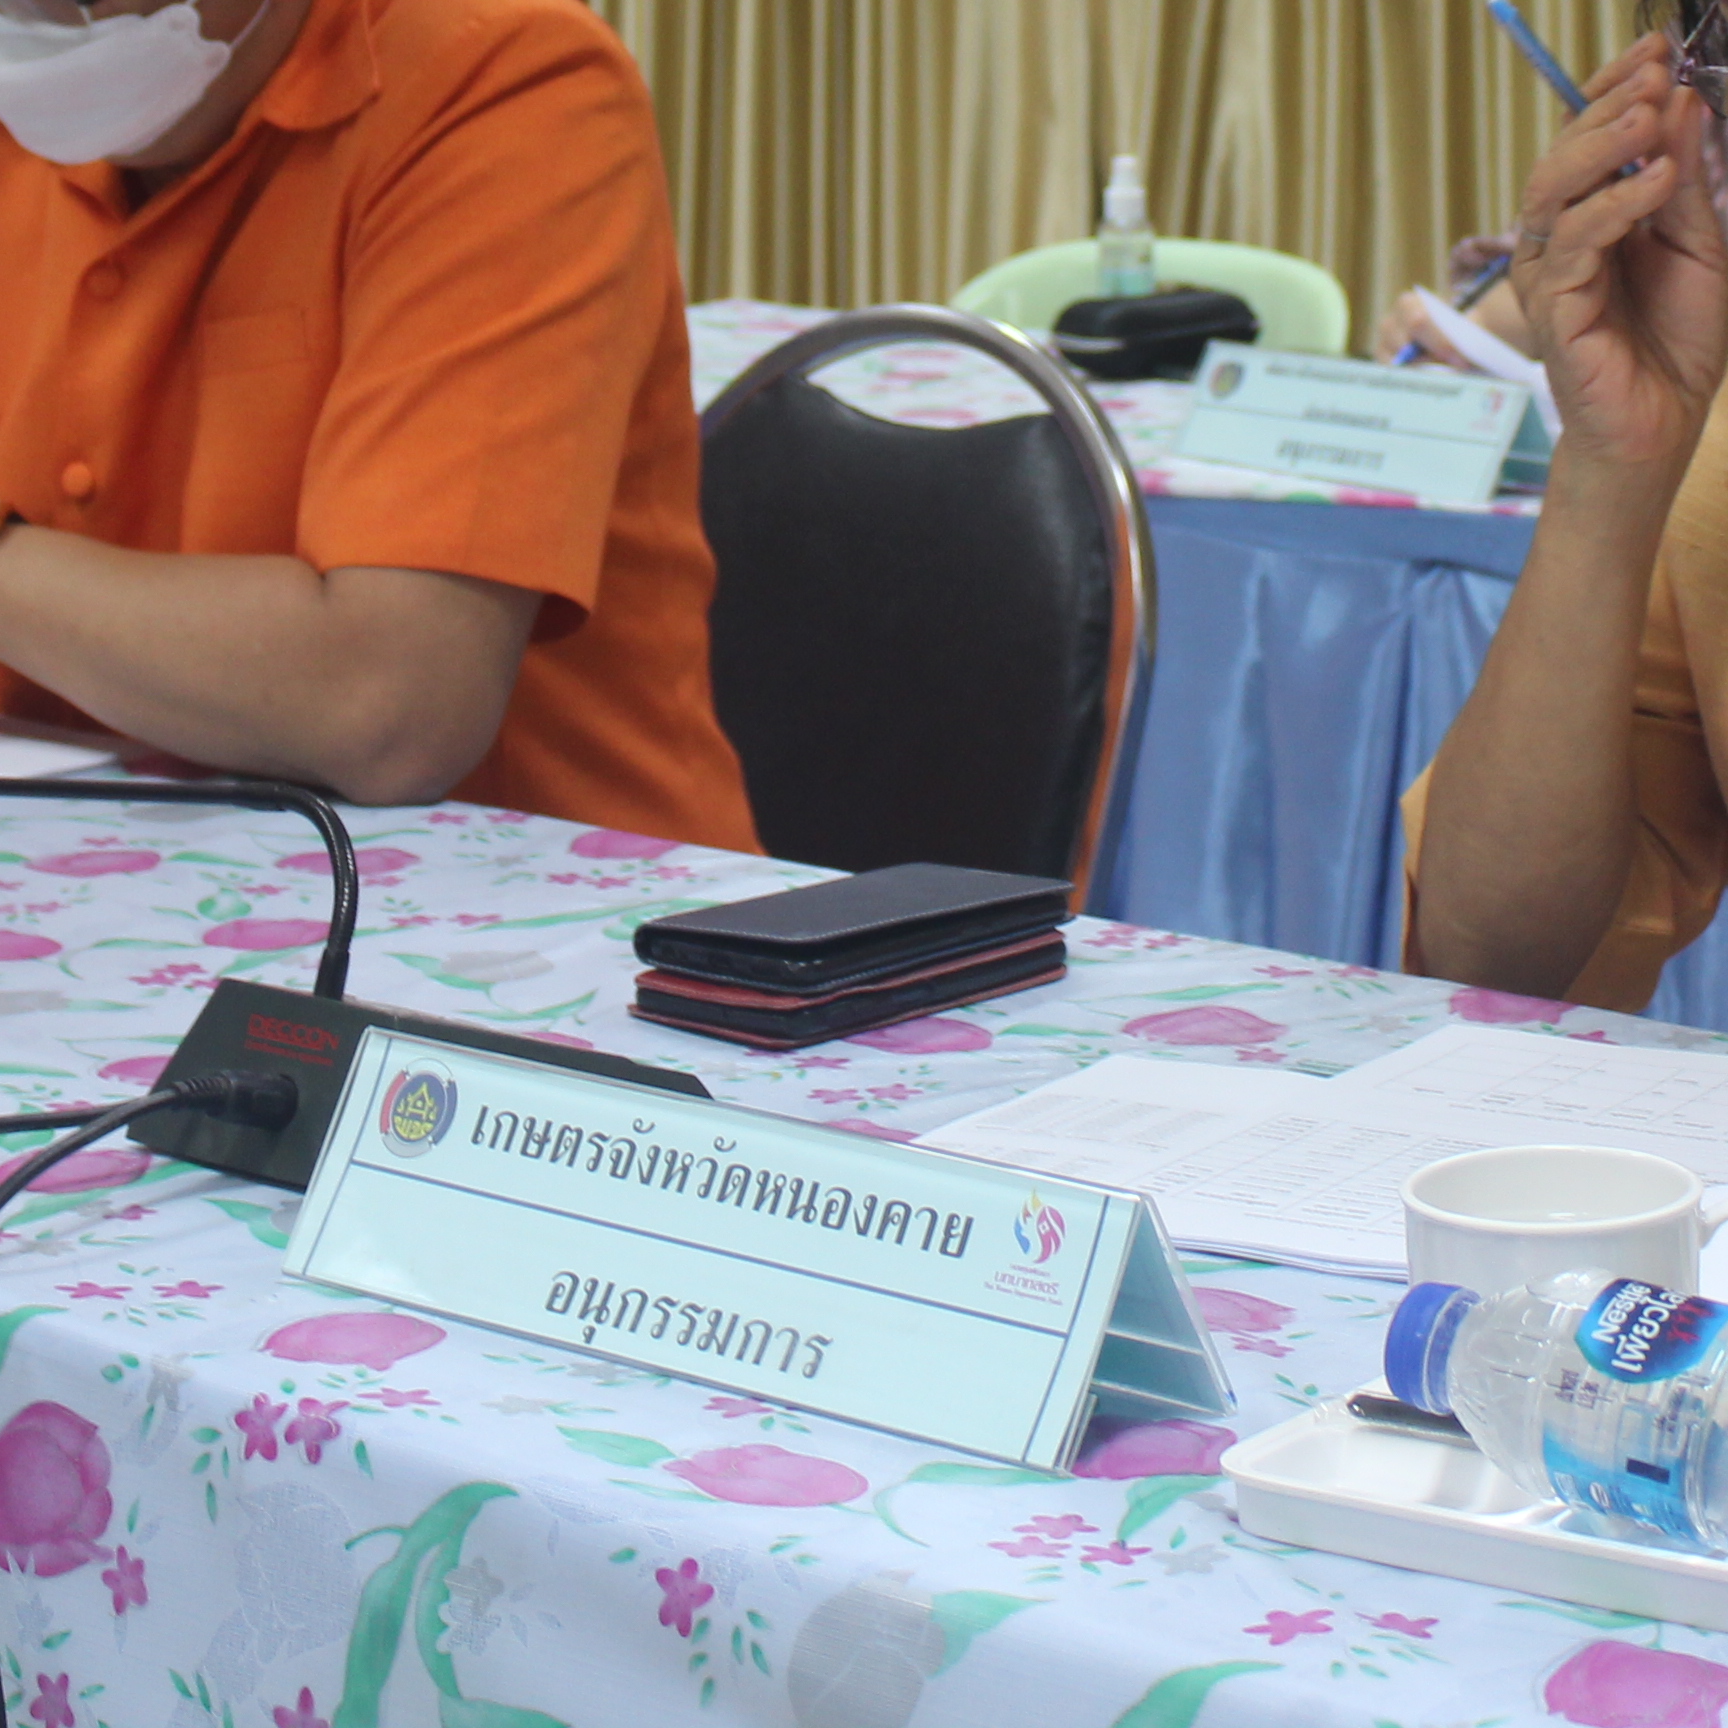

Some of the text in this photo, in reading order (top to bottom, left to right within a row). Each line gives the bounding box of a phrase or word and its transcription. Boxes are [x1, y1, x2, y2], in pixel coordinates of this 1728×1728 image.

[470, 1104, 975, 1260] เกษตรจังหวัดหนองคาย
[544, 1269, 834, 1380] อนุกรรมการ
